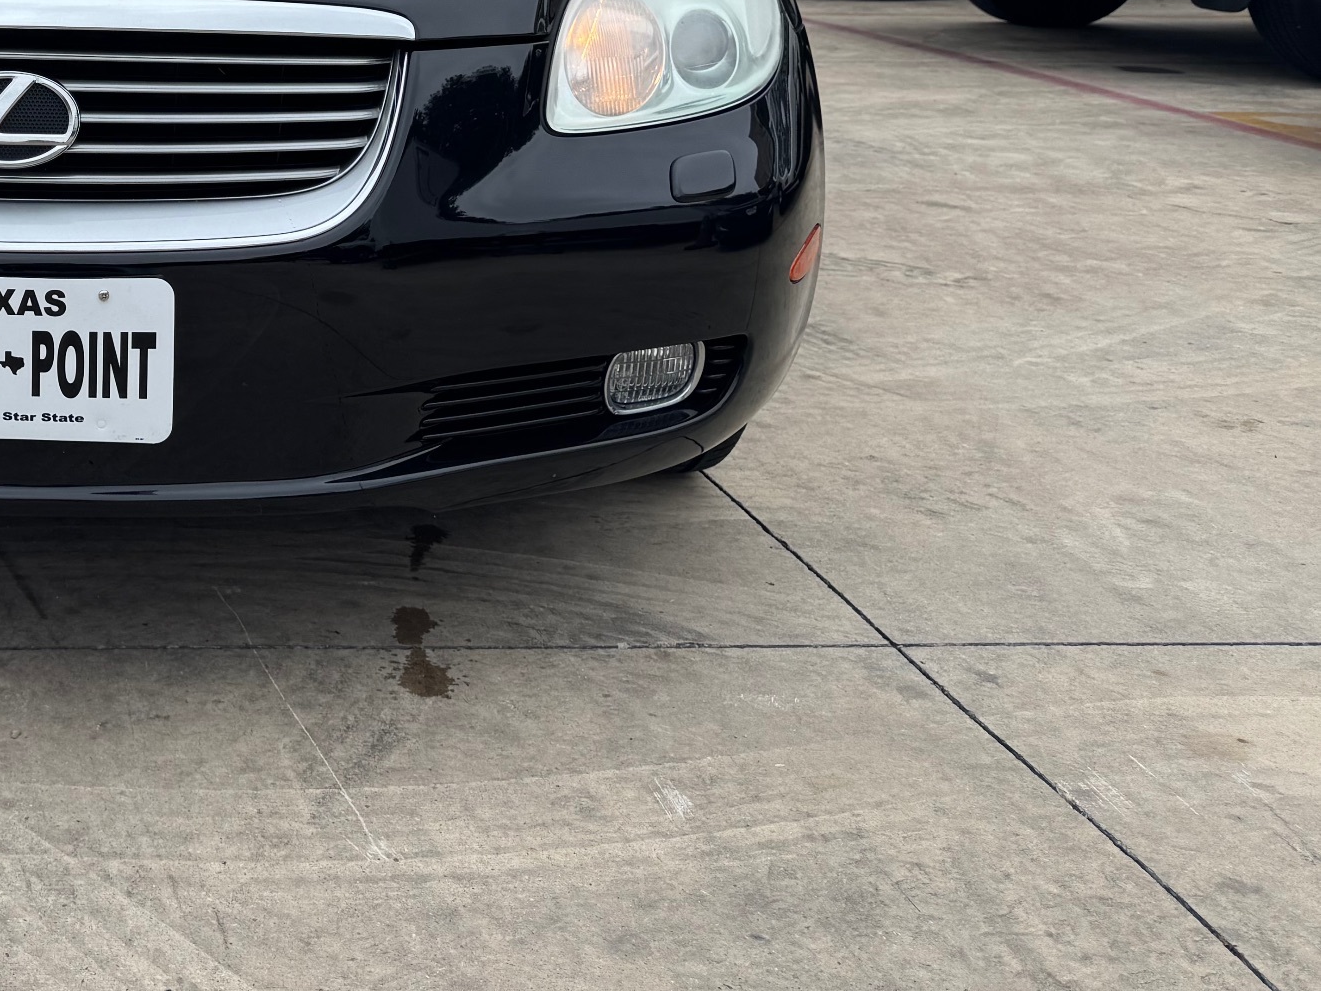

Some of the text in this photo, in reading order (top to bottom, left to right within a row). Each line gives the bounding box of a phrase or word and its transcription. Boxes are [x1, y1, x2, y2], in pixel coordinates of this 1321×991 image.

[31, 330, 157, 400] POINT
[2, 411, 37, 422] Star
[41, 412, 85, 423] State
